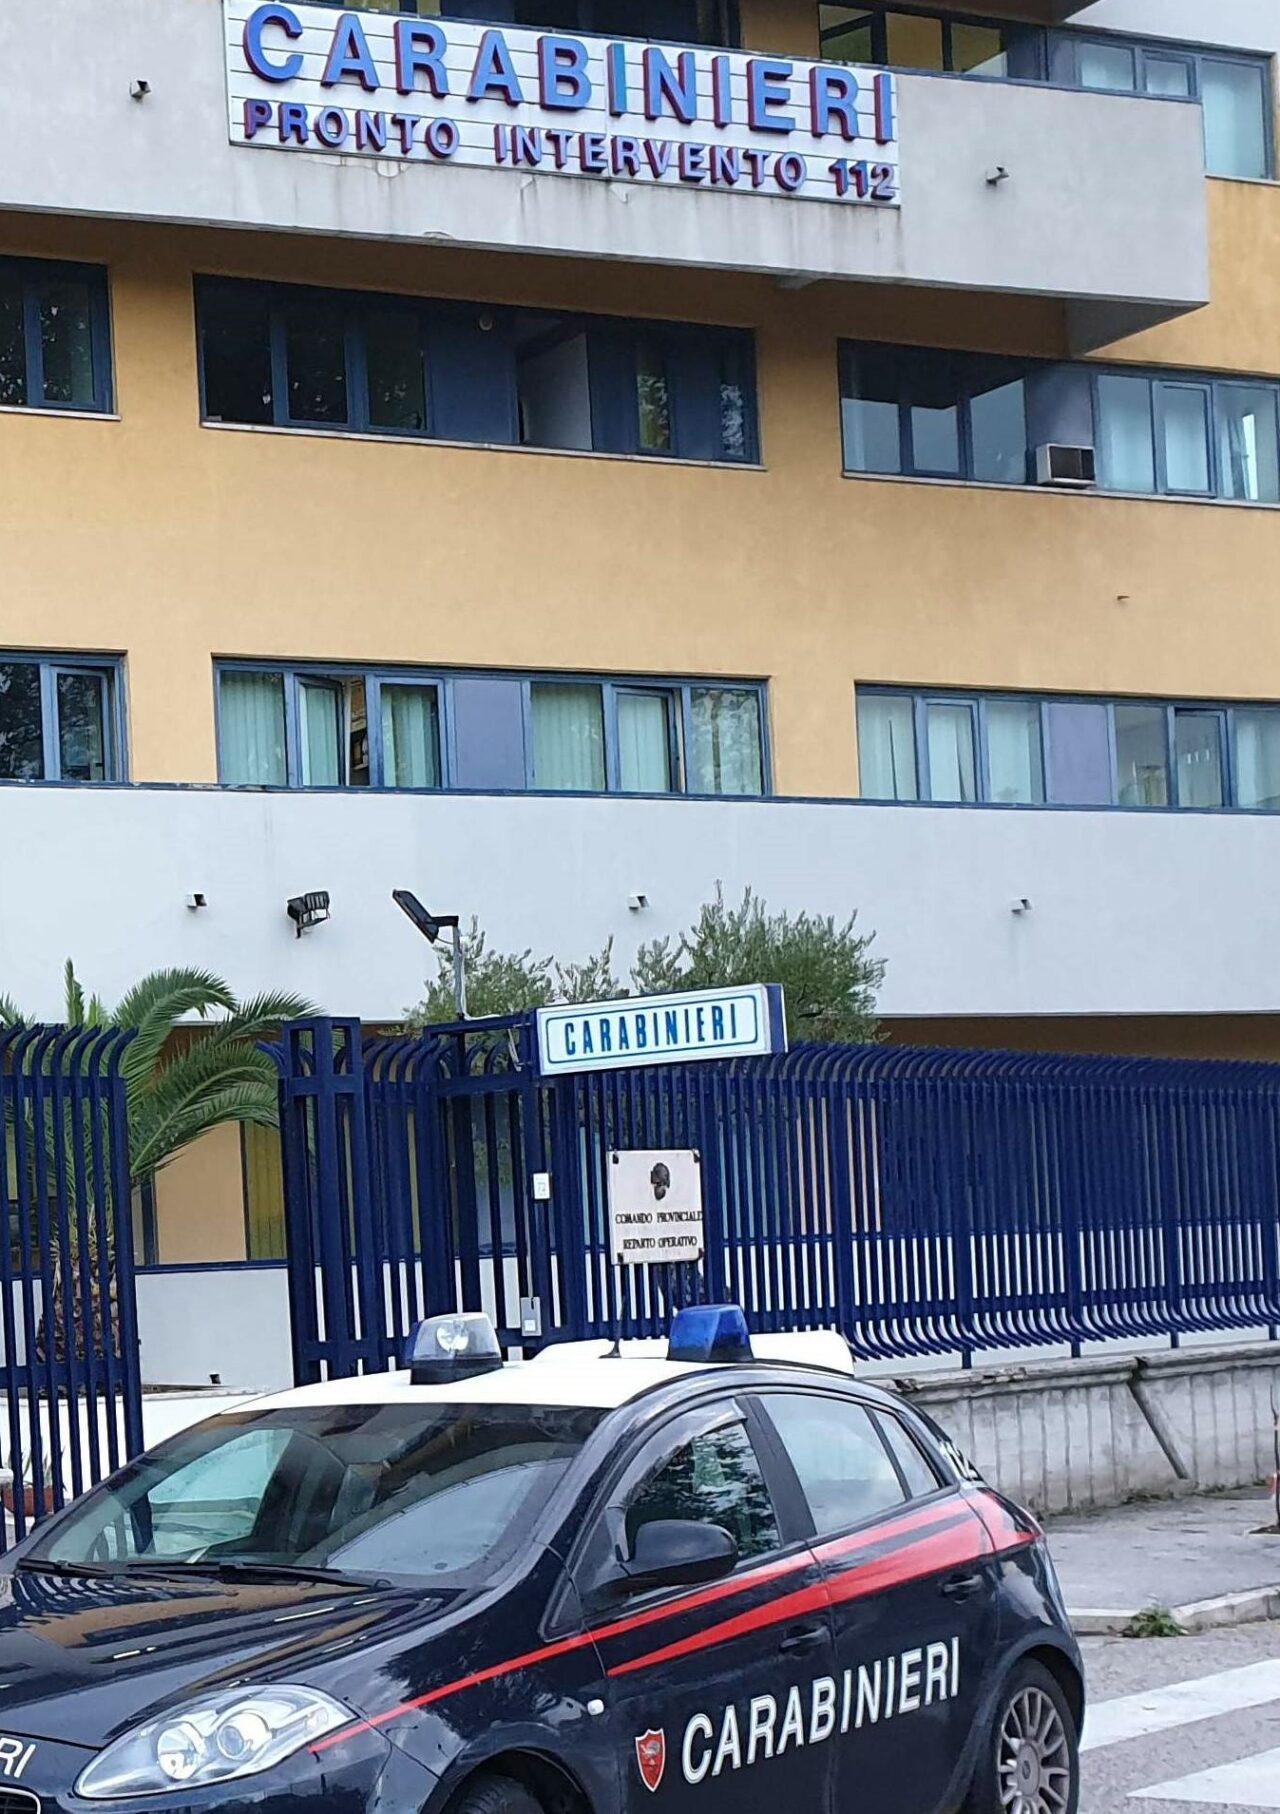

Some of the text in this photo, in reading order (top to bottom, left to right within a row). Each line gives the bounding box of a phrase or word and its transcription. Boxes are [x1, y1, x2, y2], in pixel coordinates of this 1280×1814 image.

[243, 4, 893, 145] CARABINIERI
[243, 98, 896, 200] PRONTO INTERVENTO 112
[564, 1003, 737, 1056] CARABINIERI
[615, 1211, 653, 1224] COMANDO
[682, 1636, 959, 1784] CARABINIERI
